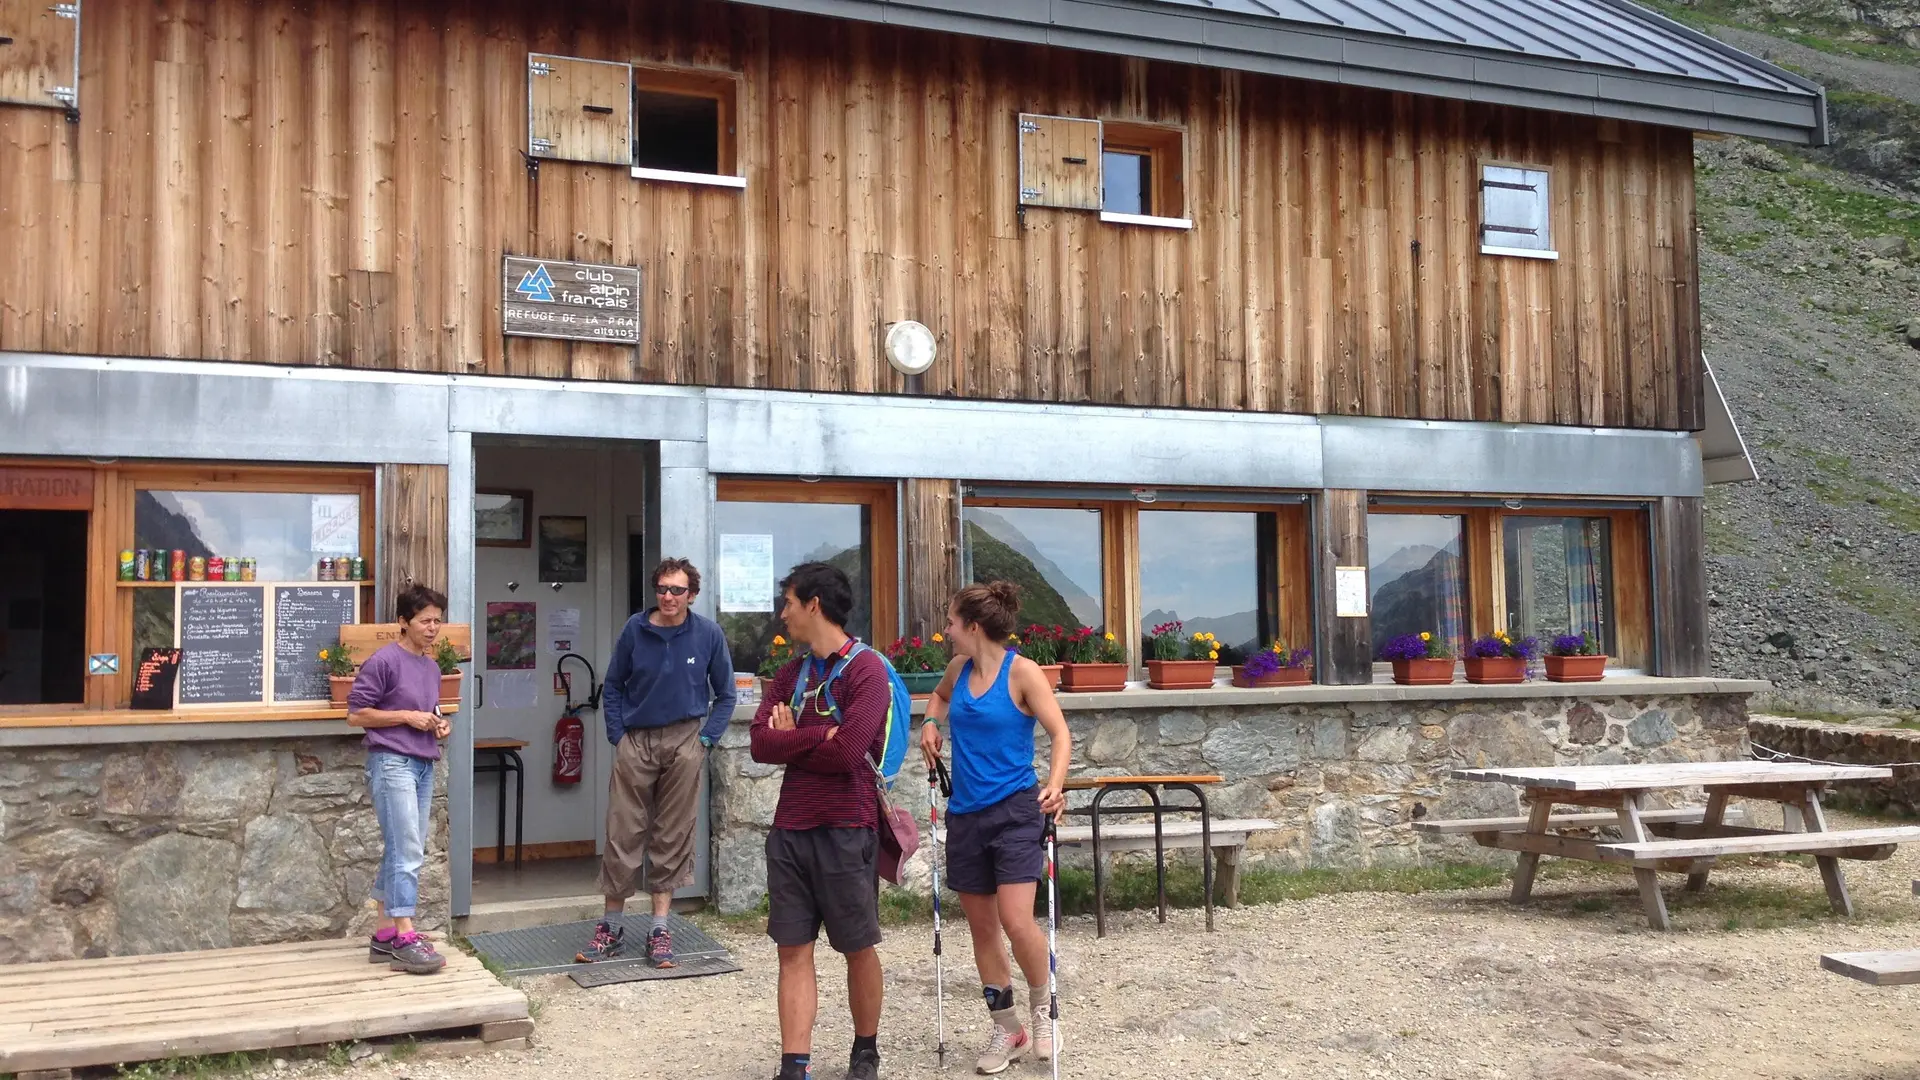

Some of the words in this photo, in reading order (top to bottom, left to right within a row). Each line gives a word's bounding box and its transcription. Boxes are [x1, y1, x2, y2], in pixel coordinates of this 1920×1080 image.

[575, 268, 614, 283] club
[589, 284, 630, 297] alpin
[561, 290, 628, 309] français
[508, 309, 556, 322] REFUGE
[562, 313, 577, 324] DE
[585, 315, 599, 325] LA
[608, 317, 634, 327] PRA
